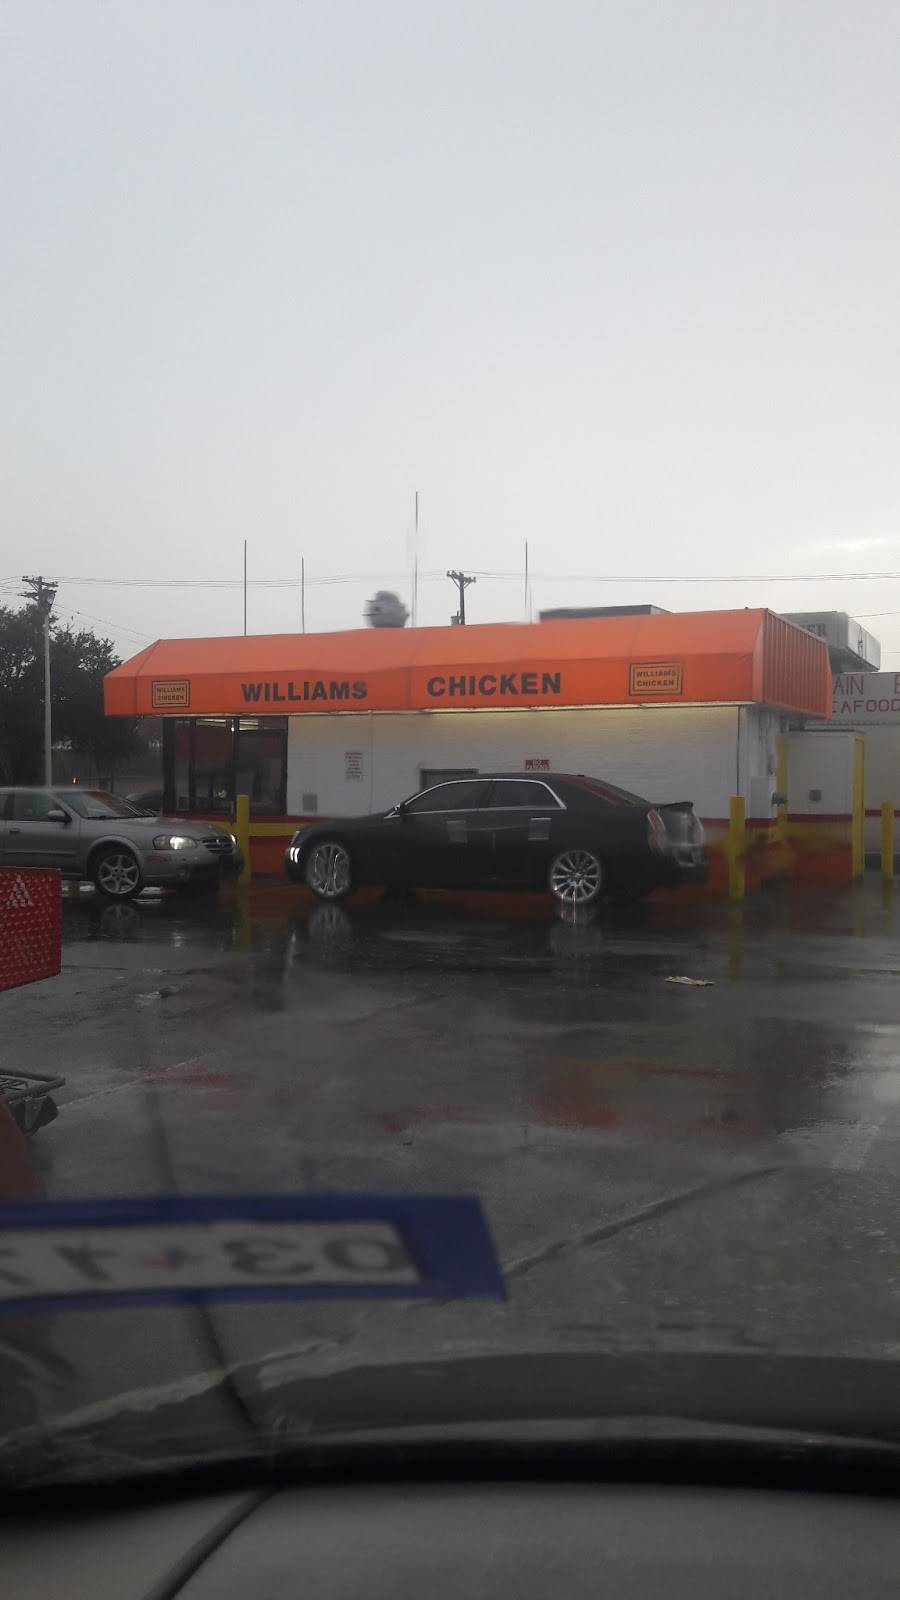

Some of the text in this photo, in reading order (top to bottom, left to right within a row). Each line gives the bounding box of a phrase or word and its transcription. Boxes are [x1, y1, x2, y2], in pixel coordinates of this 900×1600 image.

[636, 670, 676, 678] WILLIAMS
[241, 672, 562, 702] WILLIAMS CHICKEN
[637, 679, 674, 687] CHICKEN
